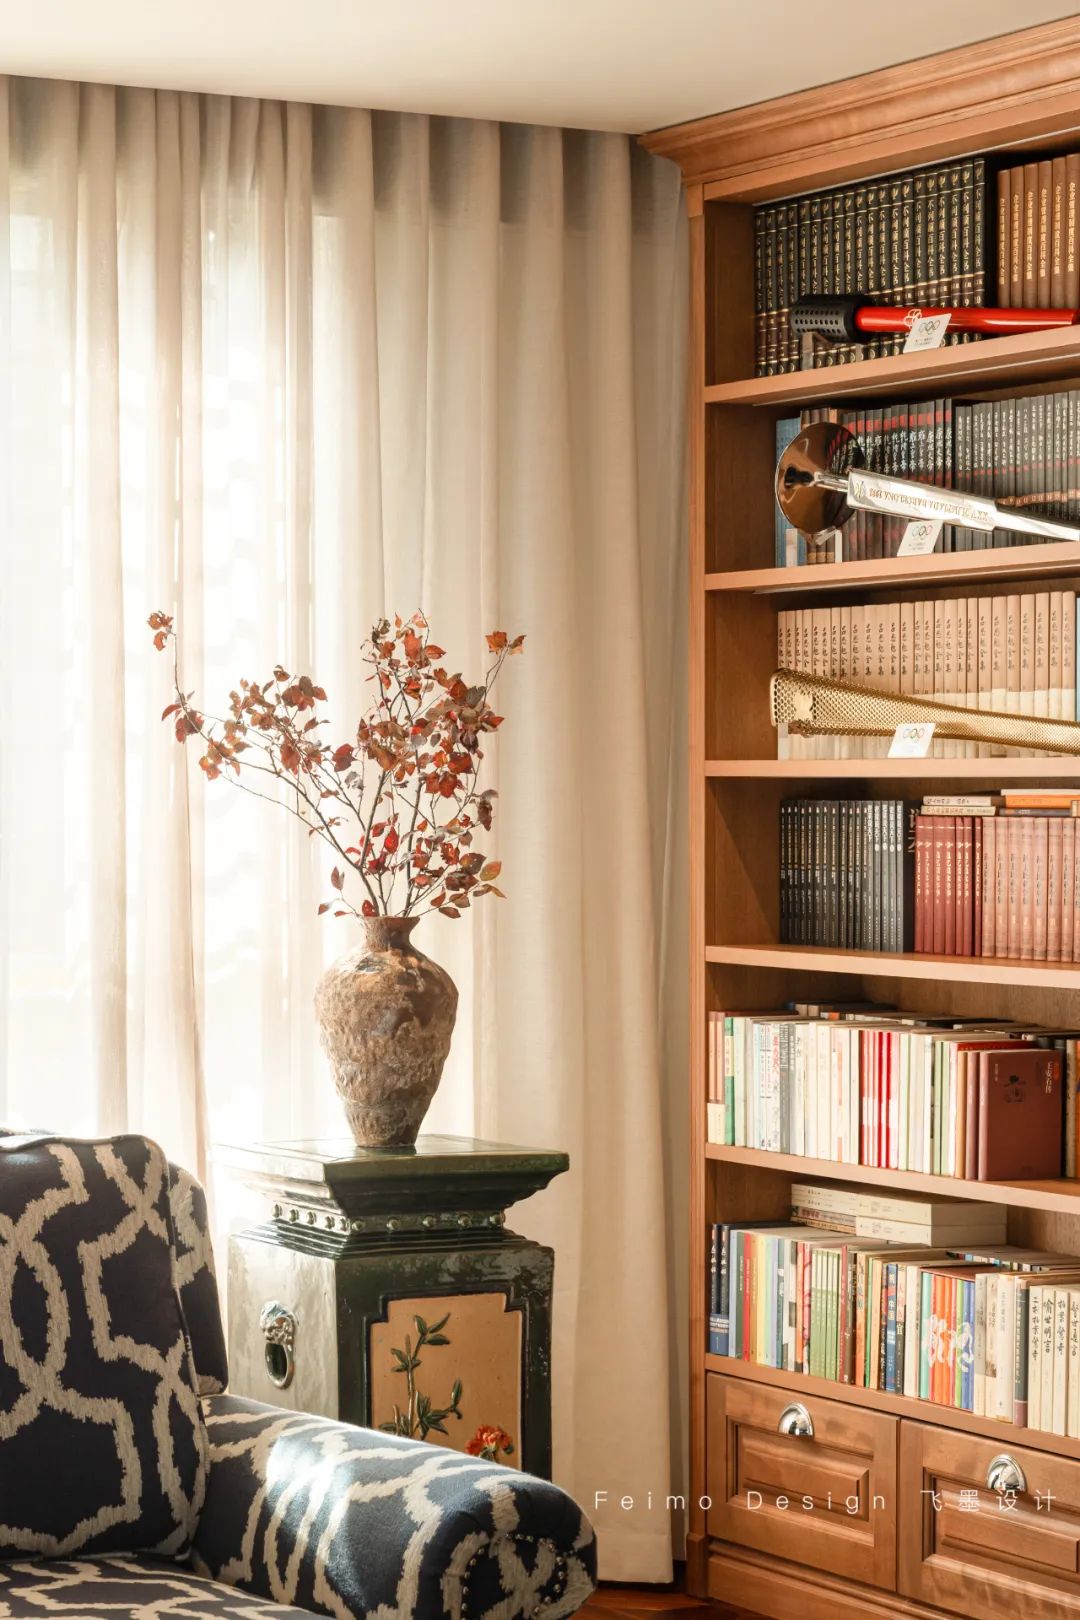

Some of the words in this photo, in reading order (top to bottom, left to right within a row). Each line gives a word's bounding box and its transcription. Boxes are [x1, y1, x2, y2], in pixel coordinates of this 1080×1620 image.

[884, 490, 927, 507] BARCELONA
[1043, 1299, 1054, 1353] 喻世明言
